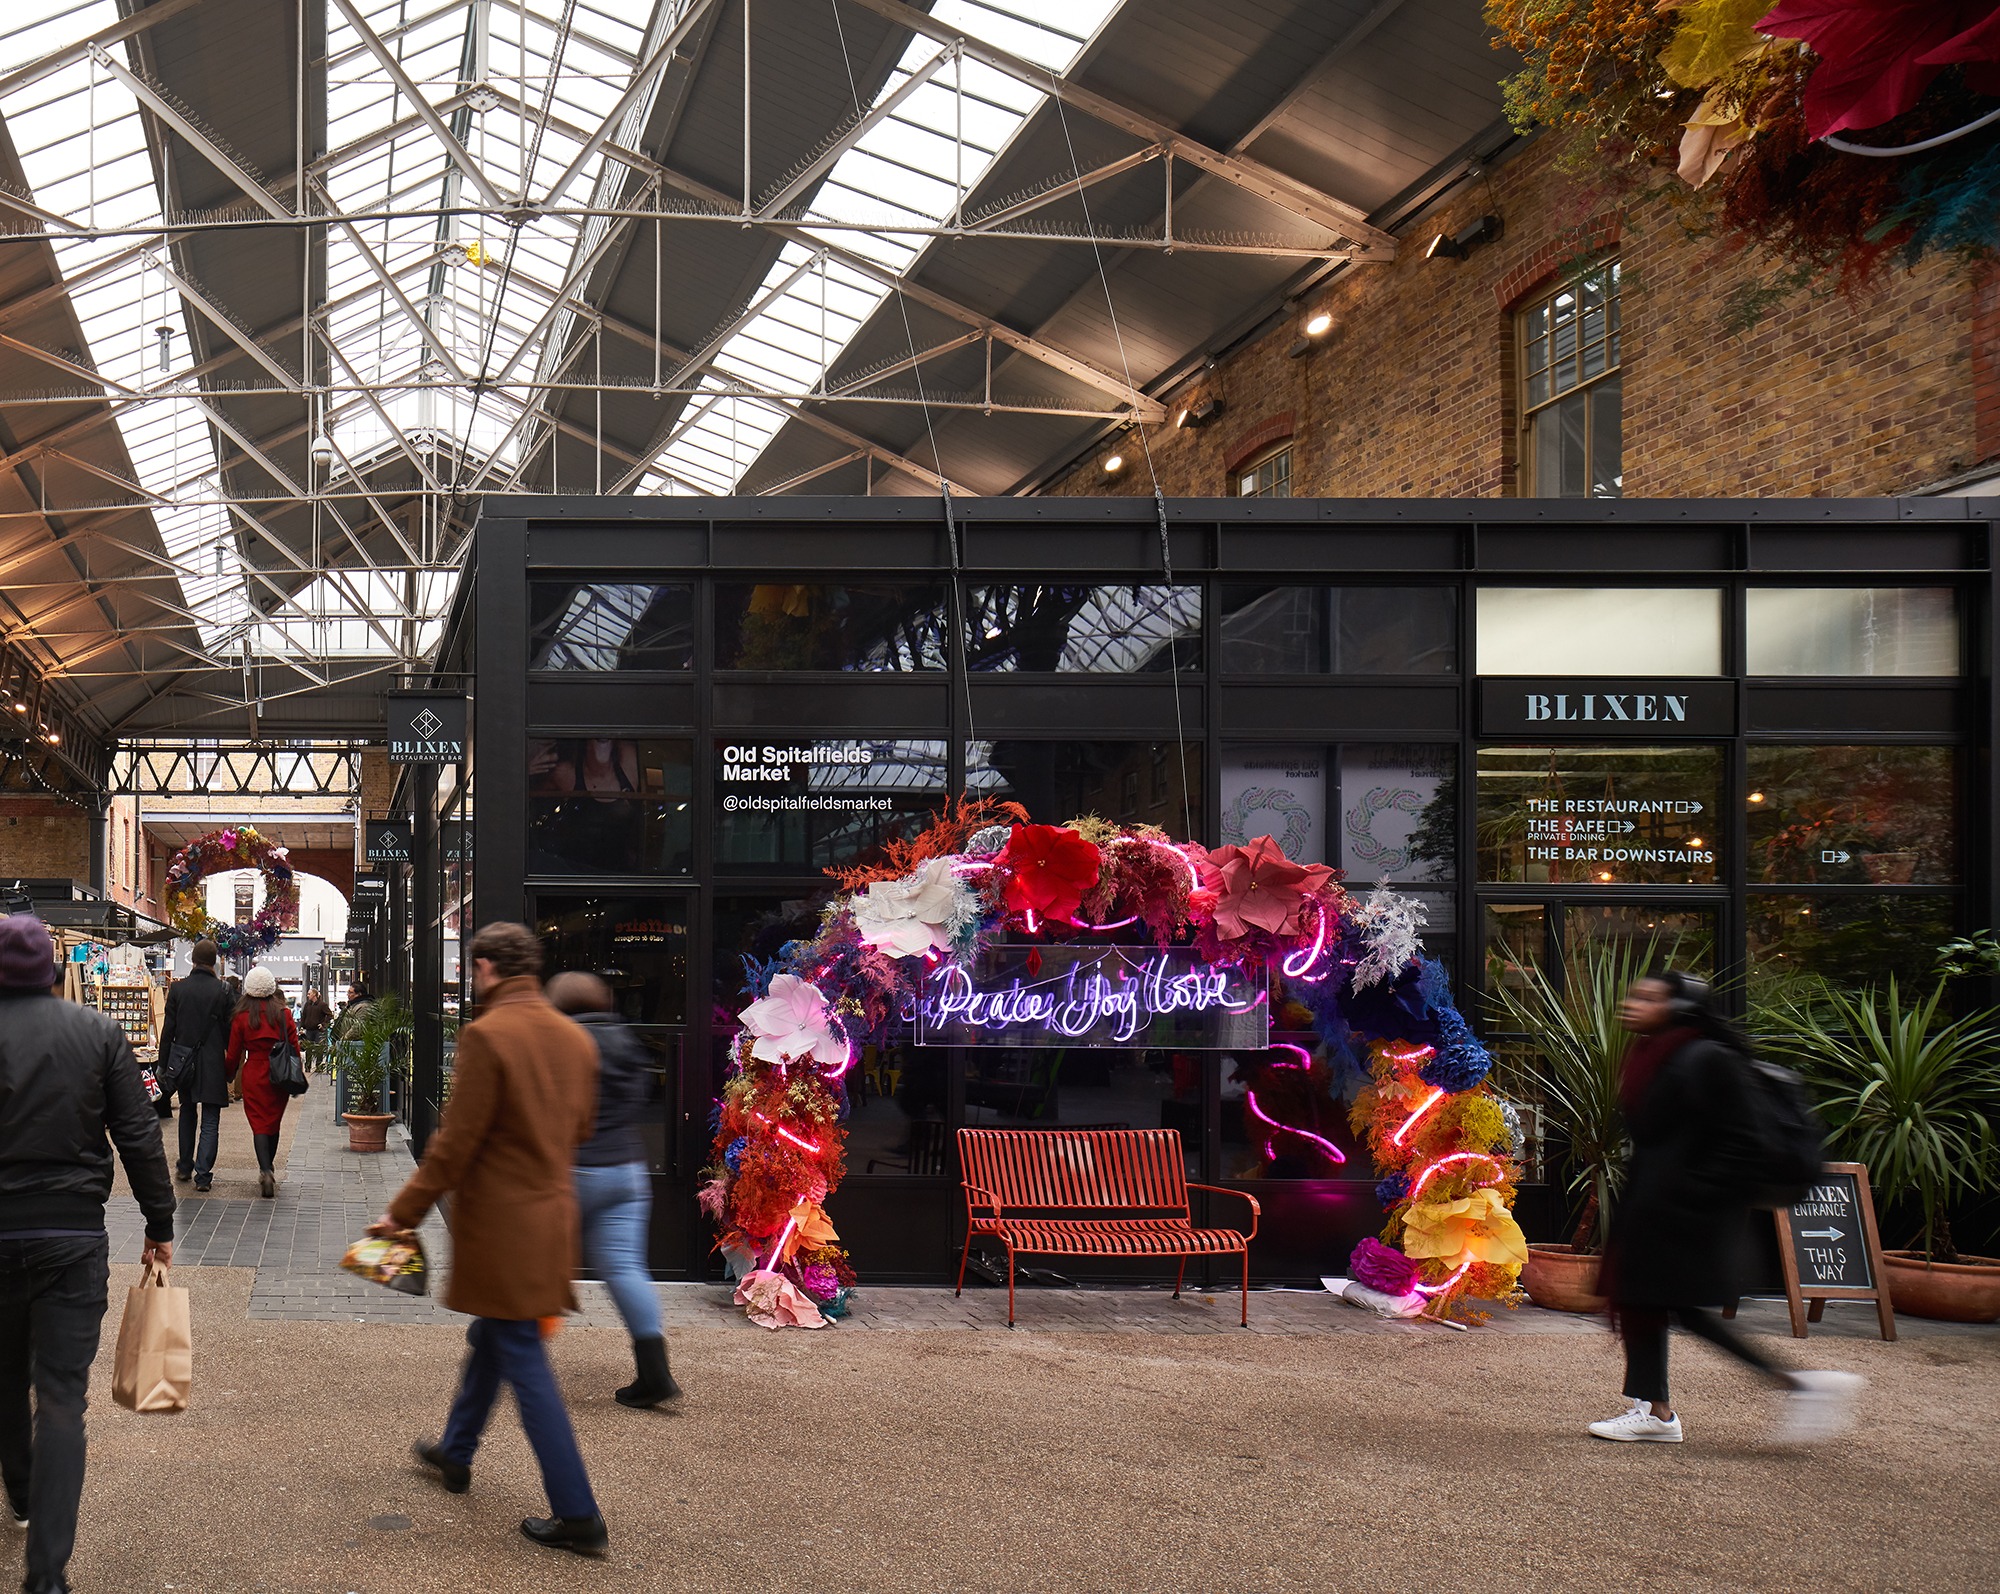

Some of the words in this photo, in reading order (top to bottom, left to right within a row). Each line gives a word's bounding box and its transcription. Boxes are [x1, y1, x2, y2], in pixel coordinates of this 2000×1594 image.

[1525, 694, 1689, 722] BLIXEN
[391, 741, 462, 754] BLIXEN
[723, 746, 757, 763] Old
[762, 746, 872, 766] Spitalfields
[723, 764, 791, 782] Market
[723, 795, 893, 814] @oldspitalfieldsmarket
[1527, 800, 1559, 813] THE
[1565, 800, 1674, 814] RESTAURANT
[1527, 819, 1559, 832] THE
[1564, 820, 1605, 833] SAFE
[1527, 832, 1567, 841] PRIVATE
[1569, 833, 1605, 842] DINING
[367, 849, 409, 857] BLIXEN
[1527, 847, 1559, 860] THE
[1565, 848, 1598, 861] BAR
[1603, 848, 1714, 864] DOWNSTAIRS
[935, 966, 1051, 1029] Peace
[1061, 962, 1138, 1041] Joy
[1794, 1202, 1848, 1218] ENTRANCE
[1803, 1247, 1847, 1264] THIS
[1813, 1264, 1845, 1281] WAY
